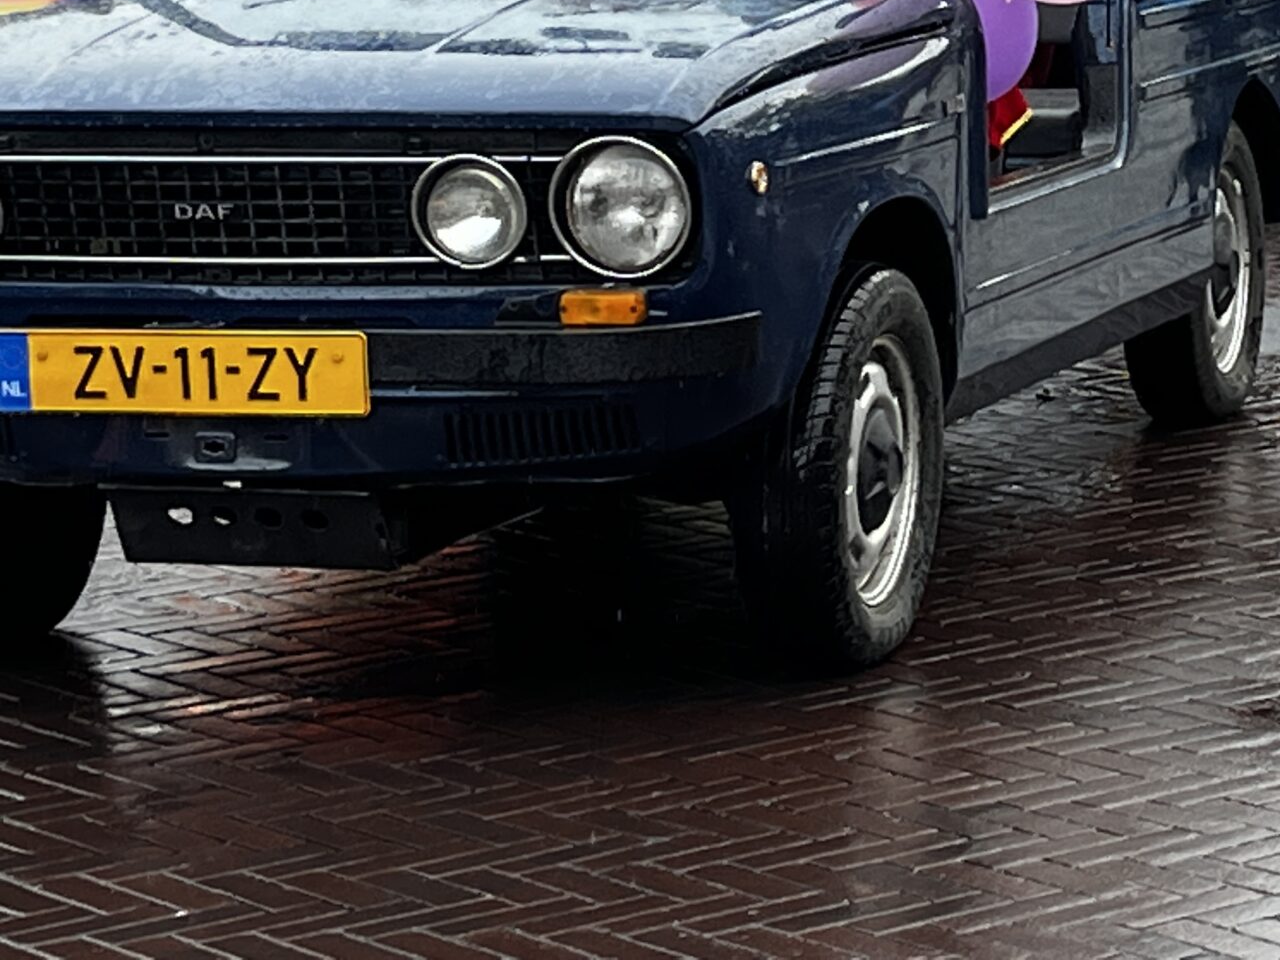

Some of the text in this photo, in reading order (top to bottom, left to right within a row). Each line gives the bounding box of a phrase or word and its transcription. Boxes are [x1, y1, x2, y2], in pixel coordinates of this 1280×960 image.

[174, 203, 234, 220] DAF
[73, 345, 319, 402] ZV-11-ZY
[2, 380, 27, 397] NL
